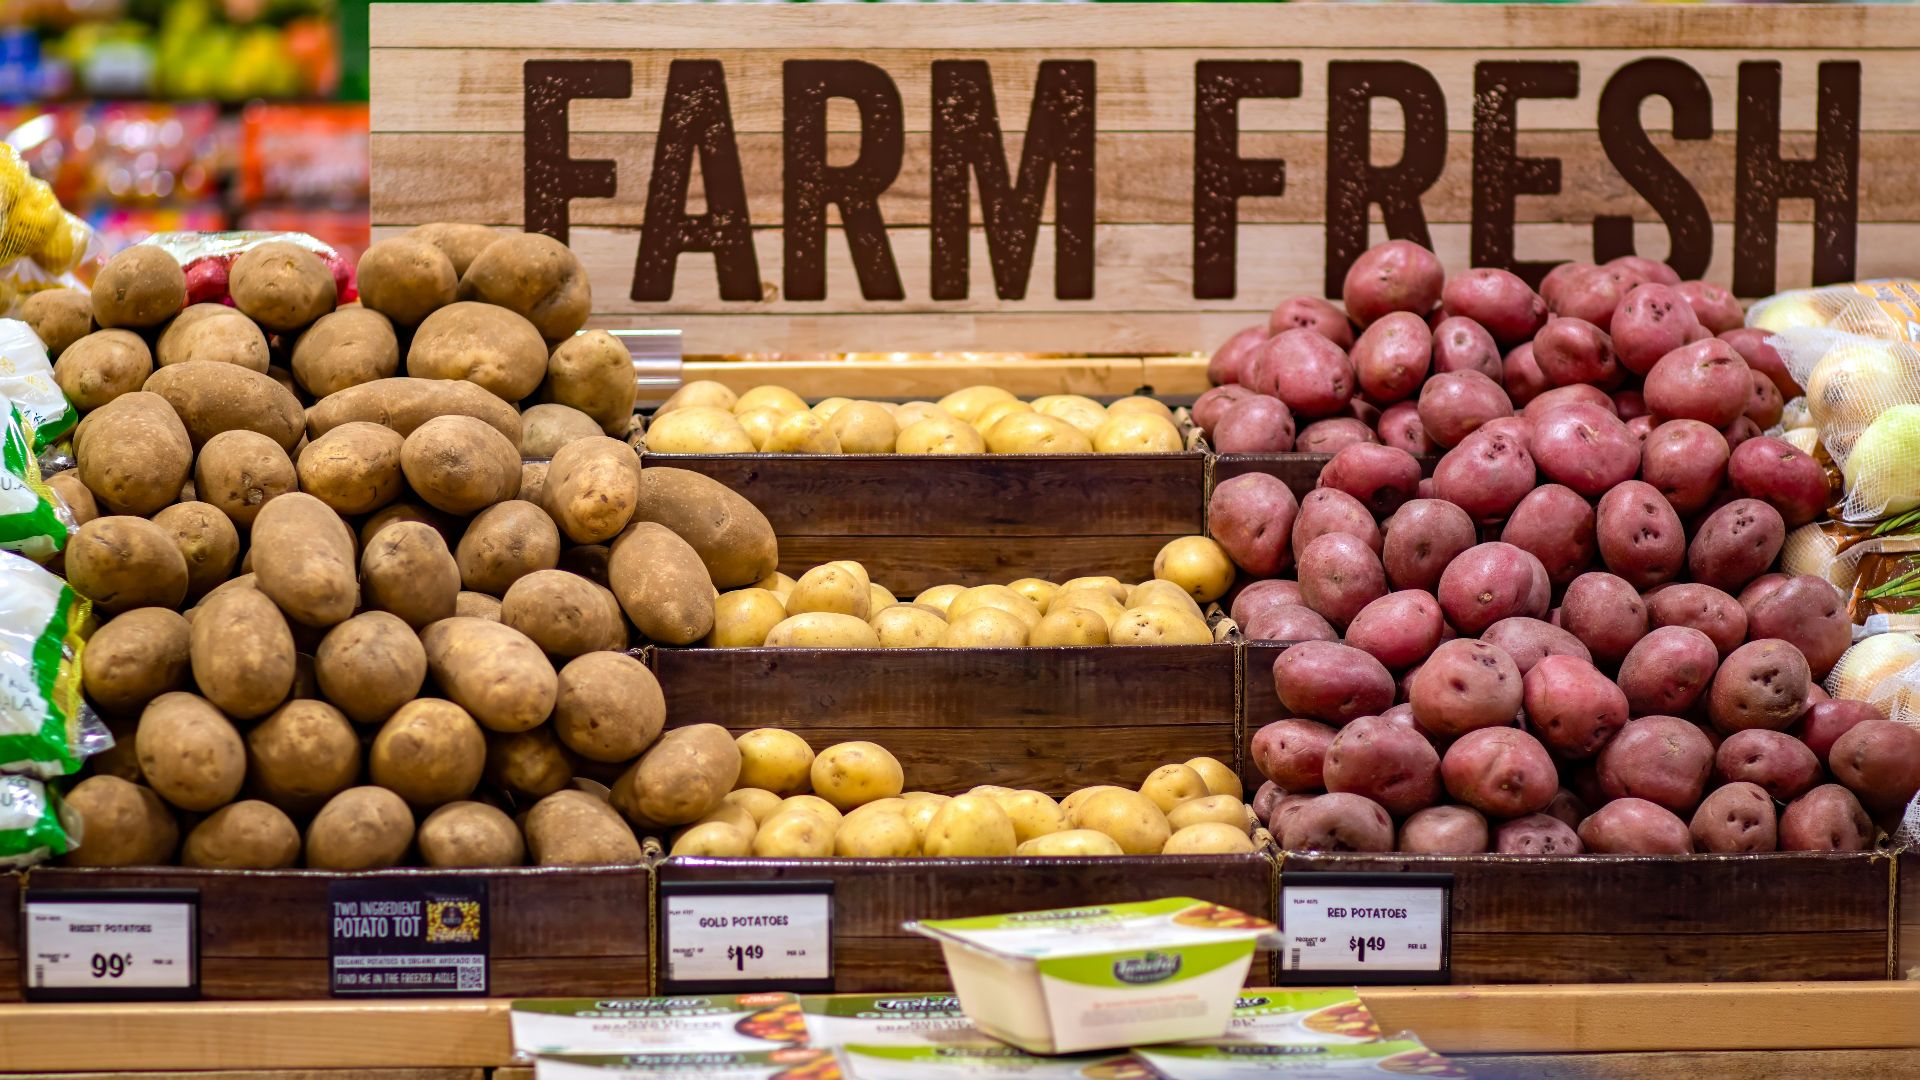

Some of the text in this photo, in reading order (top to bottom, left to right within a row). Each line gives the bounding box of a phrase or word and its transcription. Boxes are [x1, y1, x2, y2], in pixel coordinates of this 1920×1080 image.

[524, 57, 1861, 302] FARM FRESH
[333, 900, 421, 916] TWO INGREDIENT
[1327, 907, 1408, 919] RED POTATOES
[333, 917, 388, 938] POTATO
[392, 916, 421, 937] TOT
[699, 915, 789, 928] GOLD POTATOES
[105, 924, 153, 933] POTATOES
[337, 972, 456, 984] FIND ME IN THE FREEZER AISLE
